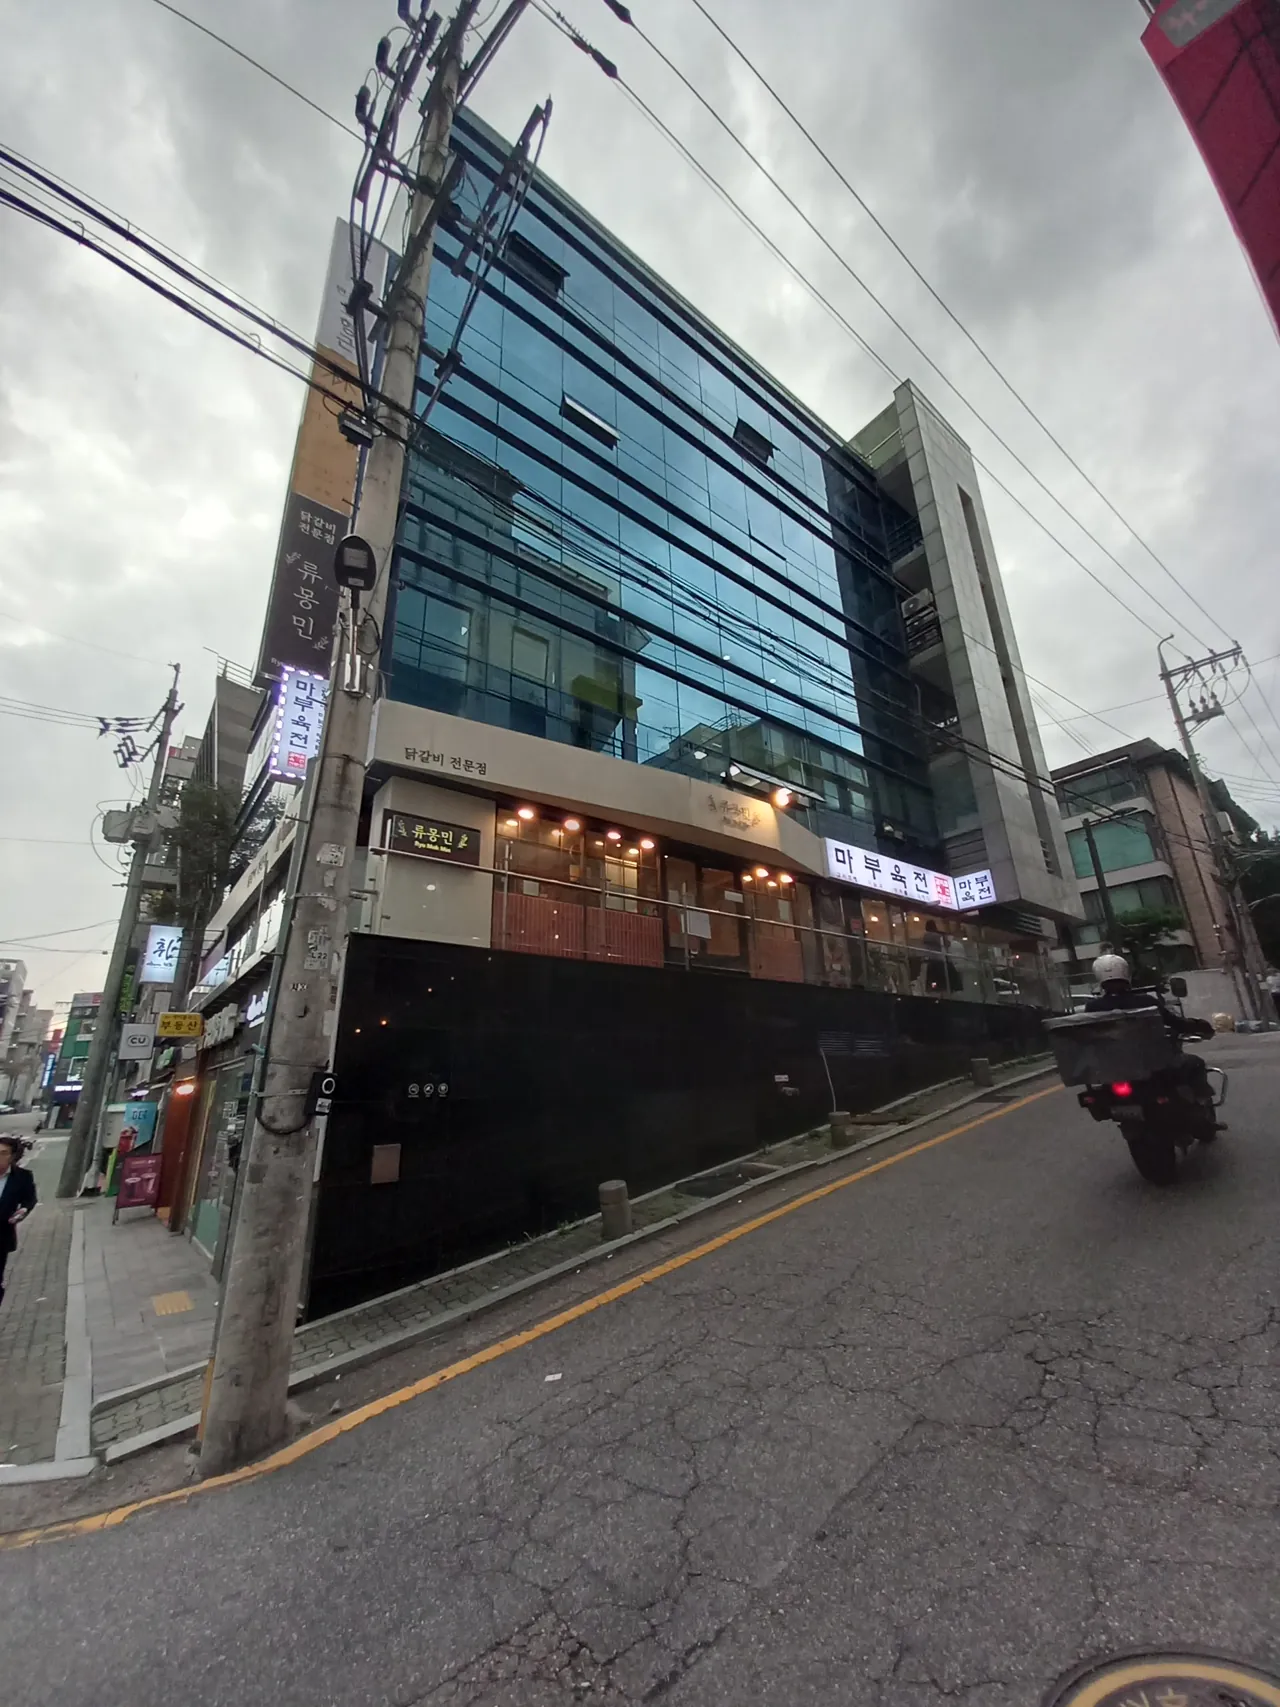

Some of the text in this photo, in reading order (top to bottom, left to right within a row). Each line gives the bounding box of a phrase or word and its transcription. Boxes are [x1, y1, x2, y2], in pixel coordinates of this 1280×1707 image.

[298, 521, 335, 546] 전문점
[289, 679, 317, 750] 마부육전
[404, 747, 487, 776] 닭갈비 전문점
[834, 847, 929, 895] 마부육전
[160, 1020, 198, 1032] 부동산
[130, 1036, 147, 1045] CU
